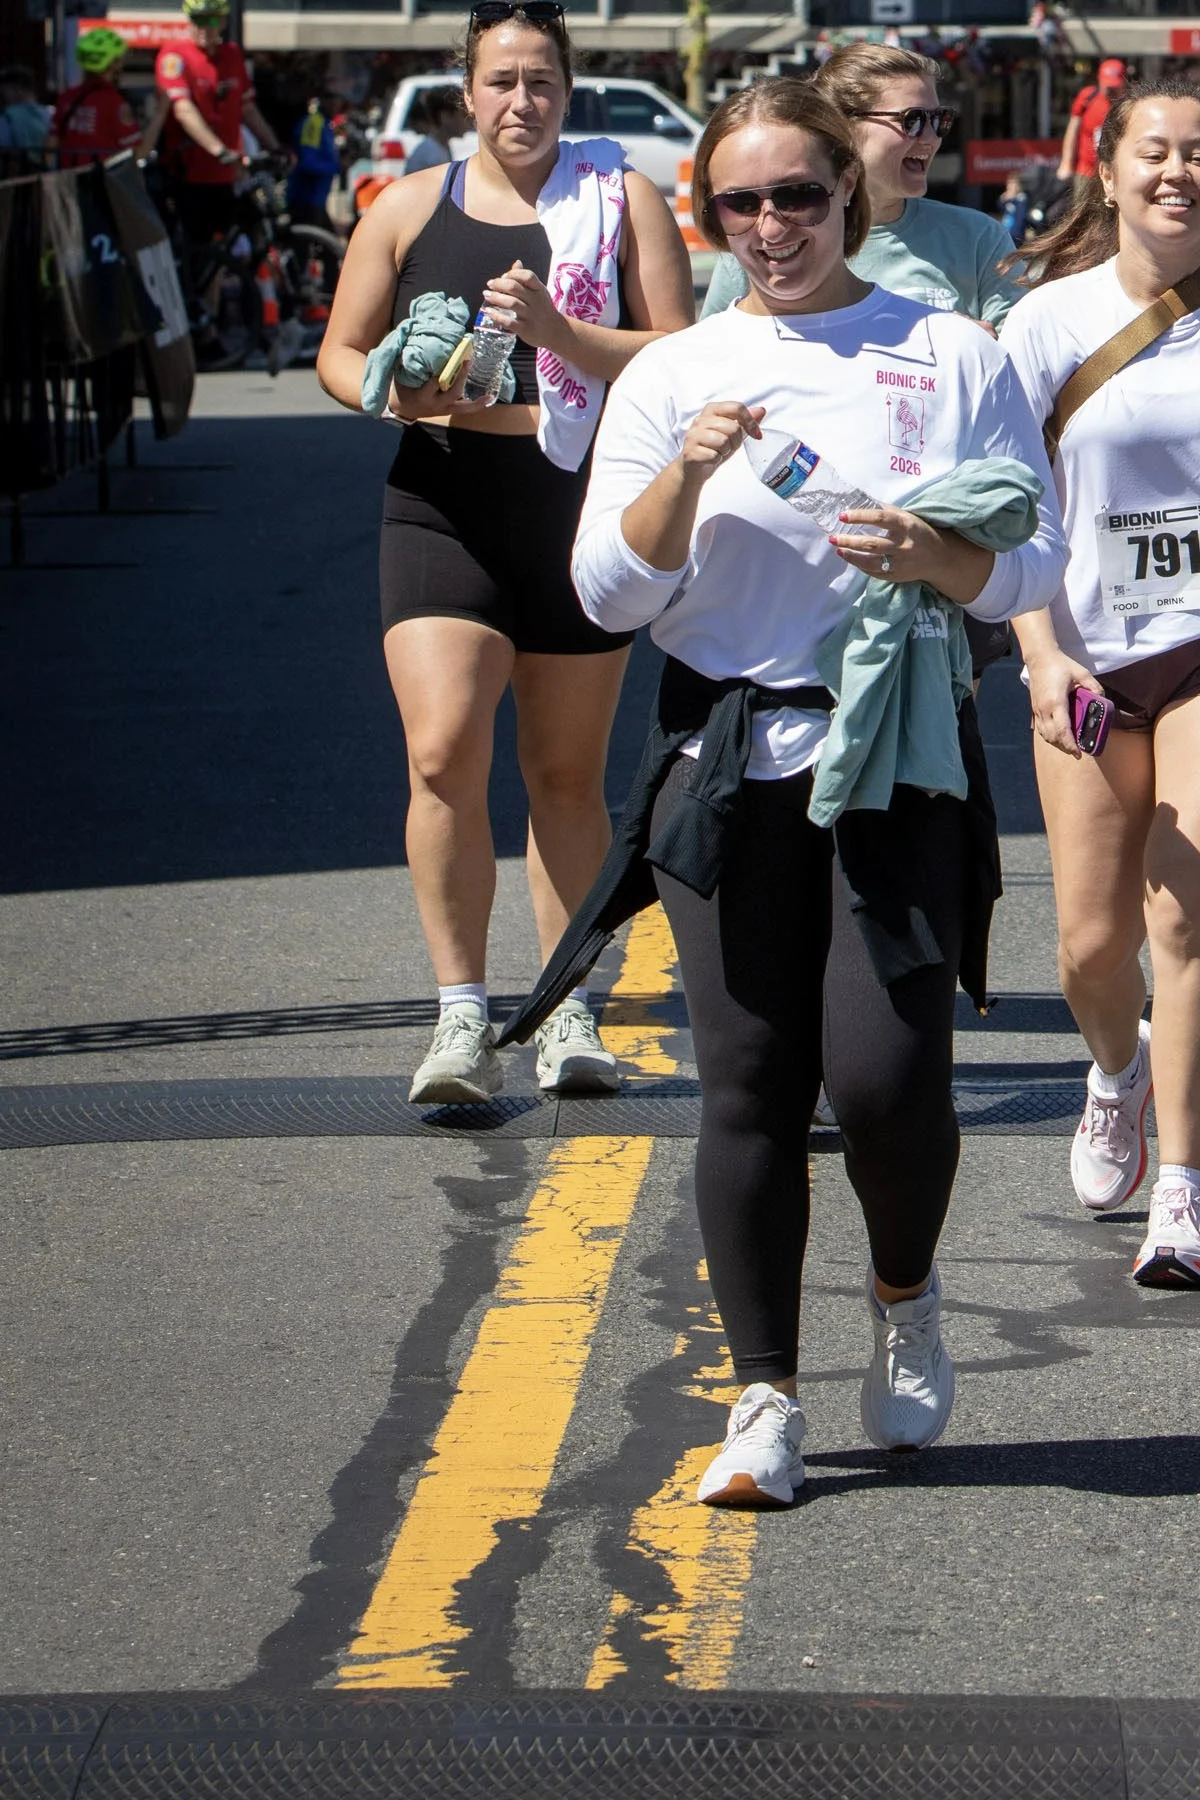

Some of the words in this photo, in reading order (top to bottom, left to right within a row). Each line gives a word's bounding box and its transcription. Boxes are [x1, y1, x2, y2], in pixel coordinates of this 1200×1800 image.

[876, 370, 916, 389] BIONIC
[919, 376, 936, 392] 5K
[890, 455, 921, 476] 2026
[1108, 506, 1199, 529] BIONIC
[1113, 602, 1139, 612] FOOD
[1157, 597, 1185, 607] DRINK
